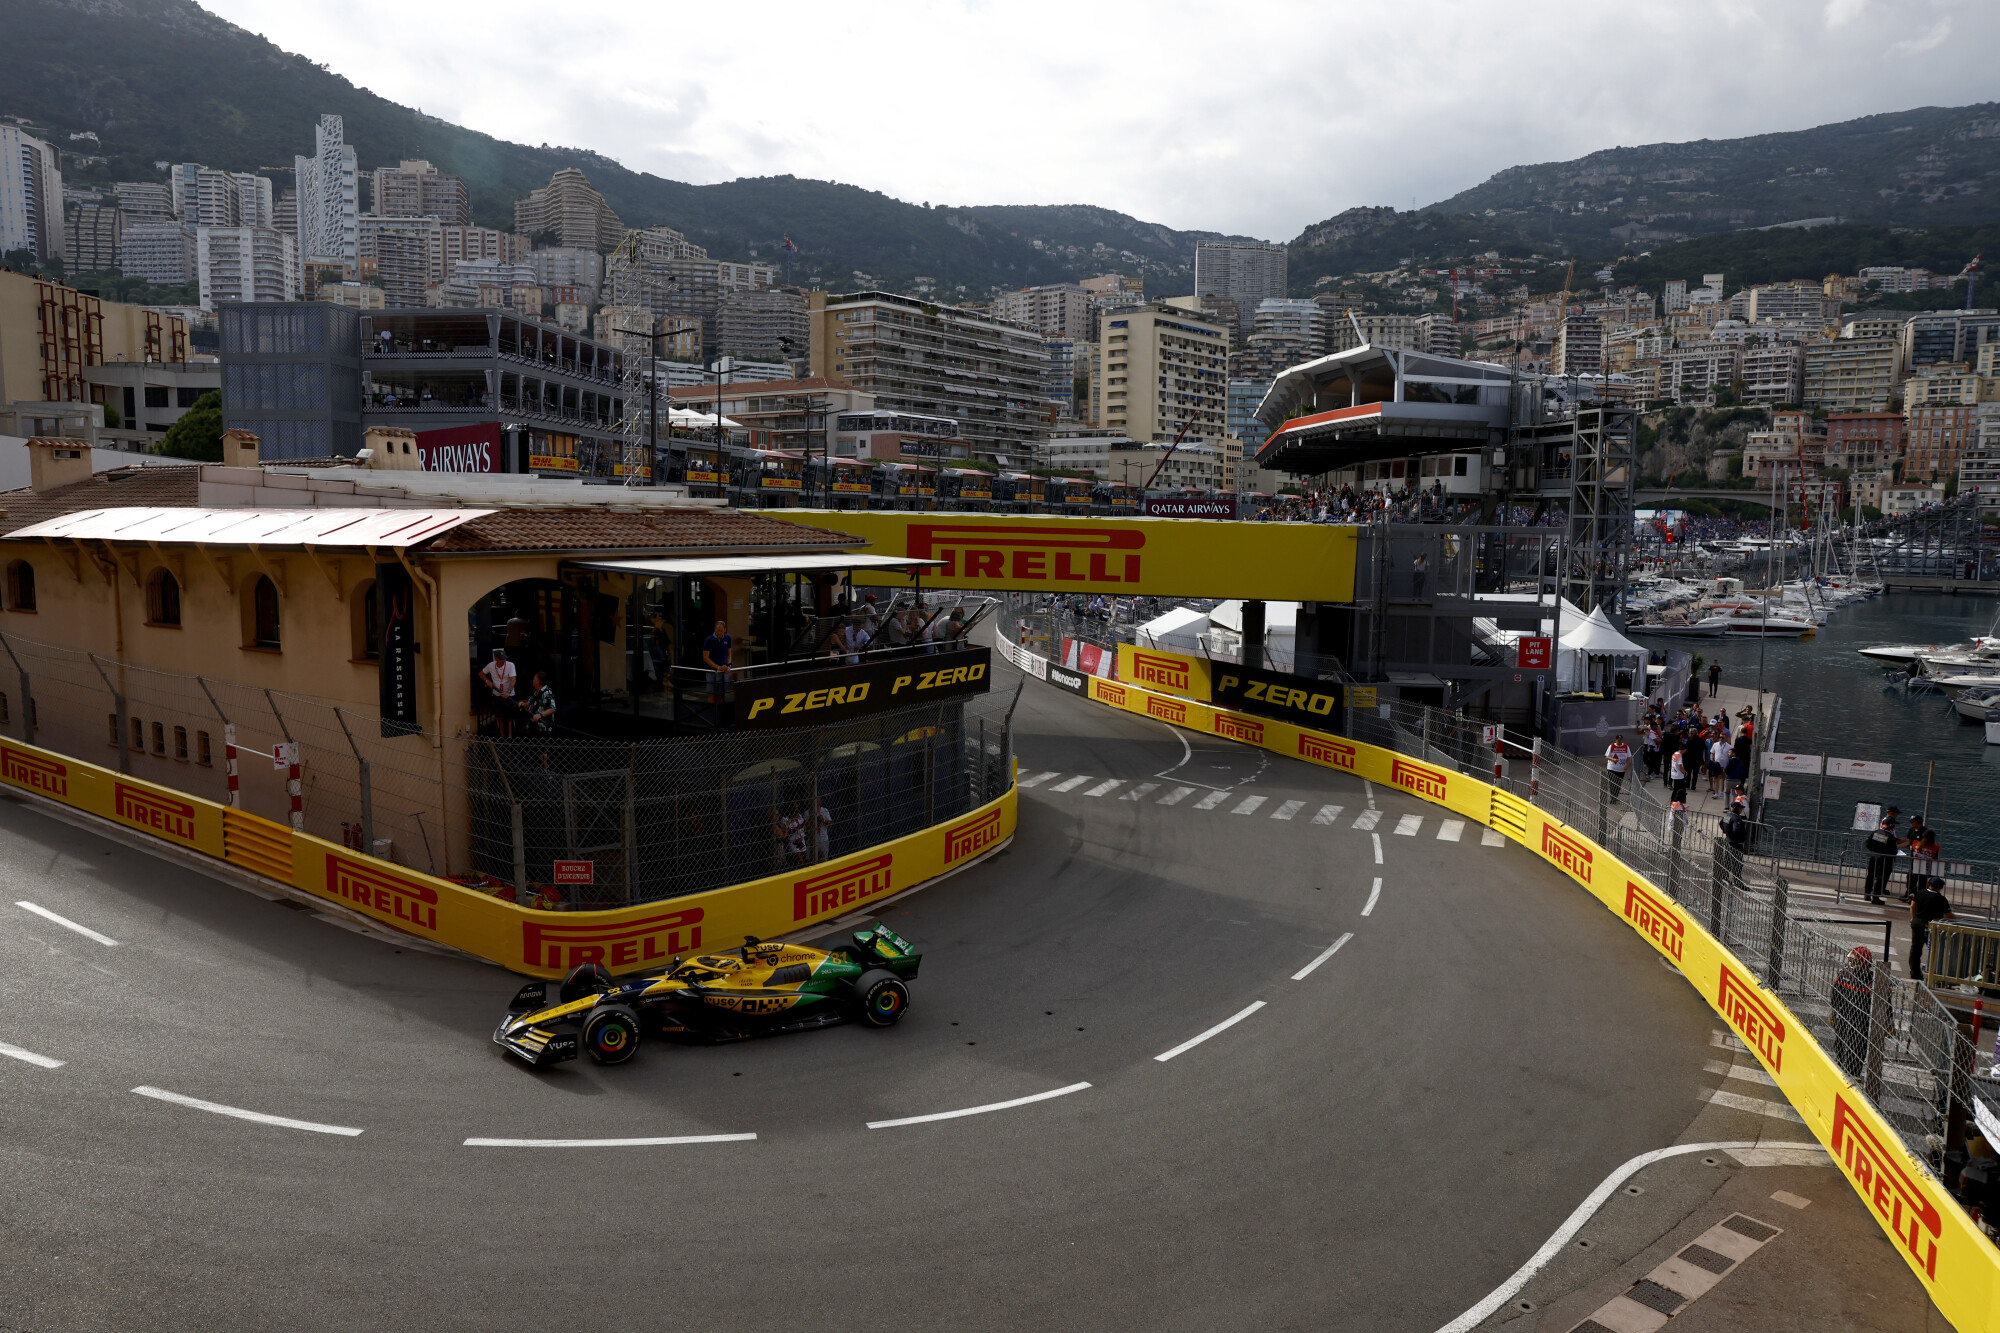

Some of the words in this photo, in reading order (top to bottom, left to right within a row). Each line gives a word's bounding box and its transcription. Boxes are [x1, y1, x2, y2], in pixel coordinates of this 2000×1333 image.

[431, 441, 491, 473] AIRWAYS
[532, 457, 553, 467] DHL
[694, 473, 711, 481] DHL
[768, 479, 784, 487] DHL
[1151, 504, 1185, 514] QATAR
[1187, 504, 1230, 514] AIRWAYS
[907, 524, 1146, 583] PIRELLI
[394, 626, 401, 641] LA
[395, 648, 403, 716] RASCASSE
[891, 675, 912, 695] P
[916, 663, 986, 690] ZERO
[1034, 659, 1044, 677] UBS
[1051, 669, 1082, 690] #MonacoGP
[1134, 653, 1189, 691] PIRELLI
[748, 697, 775, 720] P
[781, 682, 870, 714] ZERO
[1097, 681, 1126, 706] PIRELLI
[1147, 696, 1186, 724] PIRELLI
[1218, 675, 1239, 692] P
[1244, 680, 1335, 716] ZERO
[1214, 713, 1264, 744] PIRELLI
[1298, 733, 1356, 769] PIRELLI
[1, 746, 67, 797] PIRELLI
[1391, 759, 1447, 801] PIRELLI
[115, 782, 195, 841] PIRELLI
[944, 807, 1002, 865] PIRELLI
[1542, 822, 1593, 884] PIRELLI
[325, 852, 438, 931] PIRELLI
[794, 853, 893, 921] PIRELLI
[523, 907, 704, 969] PIRELLI
[1624, 880, 1685, 963] PIRELLI
[753, 943, 779, 952] vuse
[780, 951, 816, 963] chrome
[829, 952, 848, 965] 81
[705, 996, 735, 1007] vuse
[741, 998, 788, 1012] OKX
[1717, 963, 1786, 1075] PIRELLI
[1831, 1091, 1942, 1282] PIRELLI
